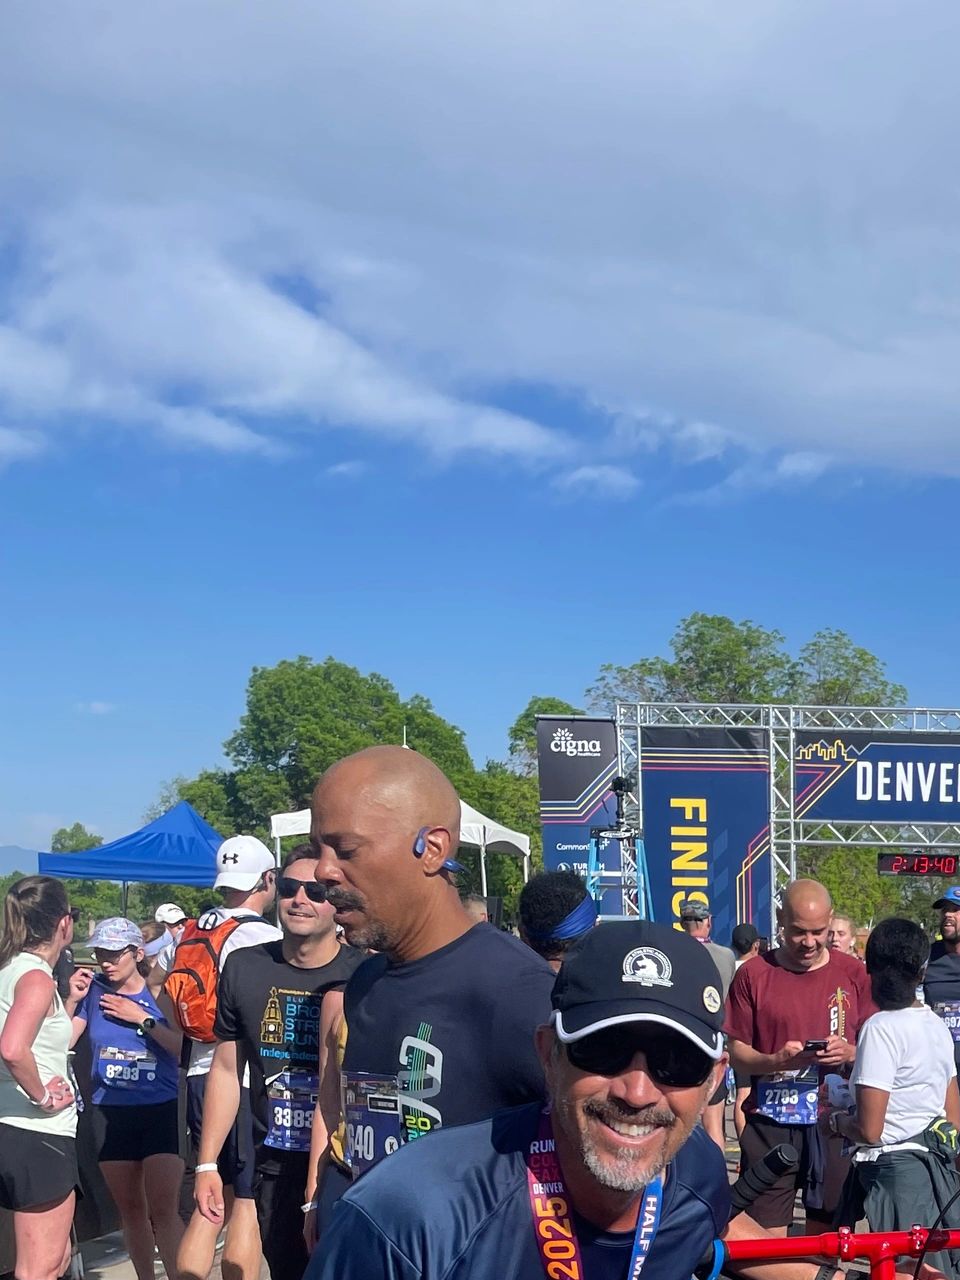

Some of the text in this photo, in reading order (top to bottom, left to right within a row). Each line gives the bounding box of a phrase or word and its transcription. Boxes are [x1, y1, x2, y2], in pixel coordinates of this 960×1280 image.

[550, 738, 601, 757] cigna
[670, 798, 709, 931] FINIS
[892, 857, 956, 874] 2:13:40
[286, 1004, 320, 1018] BRO
[260, 1047, 320, 1062] Independen
[765, 1089, 799, 1105] 2793
[274, 1106, 314, 1128] 3383
[405, 1115, 431, 1130] 20
[530, 1139, 555, 1154] RUN
[532, 1182, 565, 1195] DENVER
[640, 1196, 658, 1252] HALF
[534, 1196, 580, 1280] 2025
